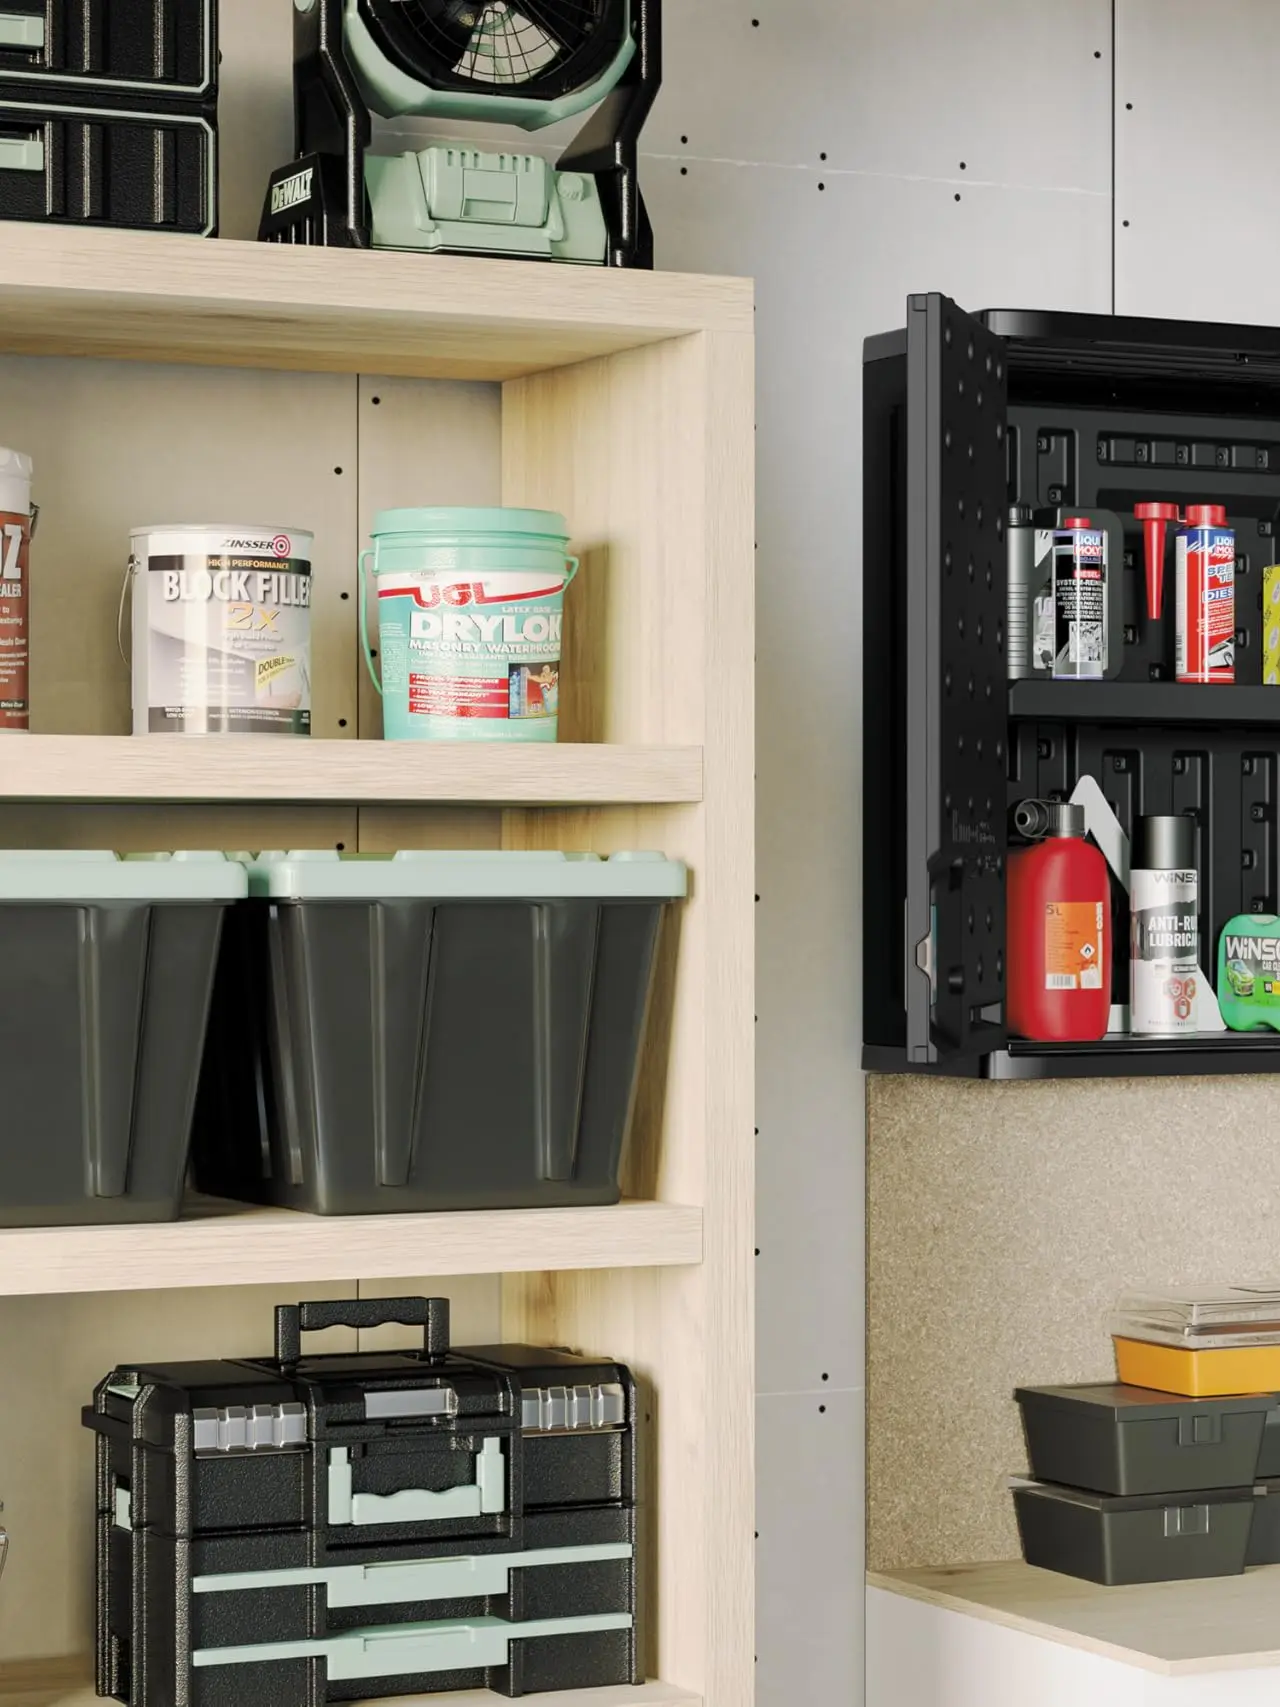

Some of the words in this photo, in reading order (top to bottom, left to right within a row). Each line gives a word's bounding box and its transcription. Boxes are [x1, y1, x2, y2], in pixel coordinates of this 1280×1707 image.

[0, 523, 22, 579] Z
[220, 539, 274, 550] ZINSSER
[232, 560, 289, 569] PERFORMANCE
[164, 571, 250, 602] BLOCK
[411, 582, 487, 609] UGL
[409, 639, 482, 653] MASONRY
[258, 656, 286, 675] DOUBLE
[1262, 961, 1272, 971] CAR
